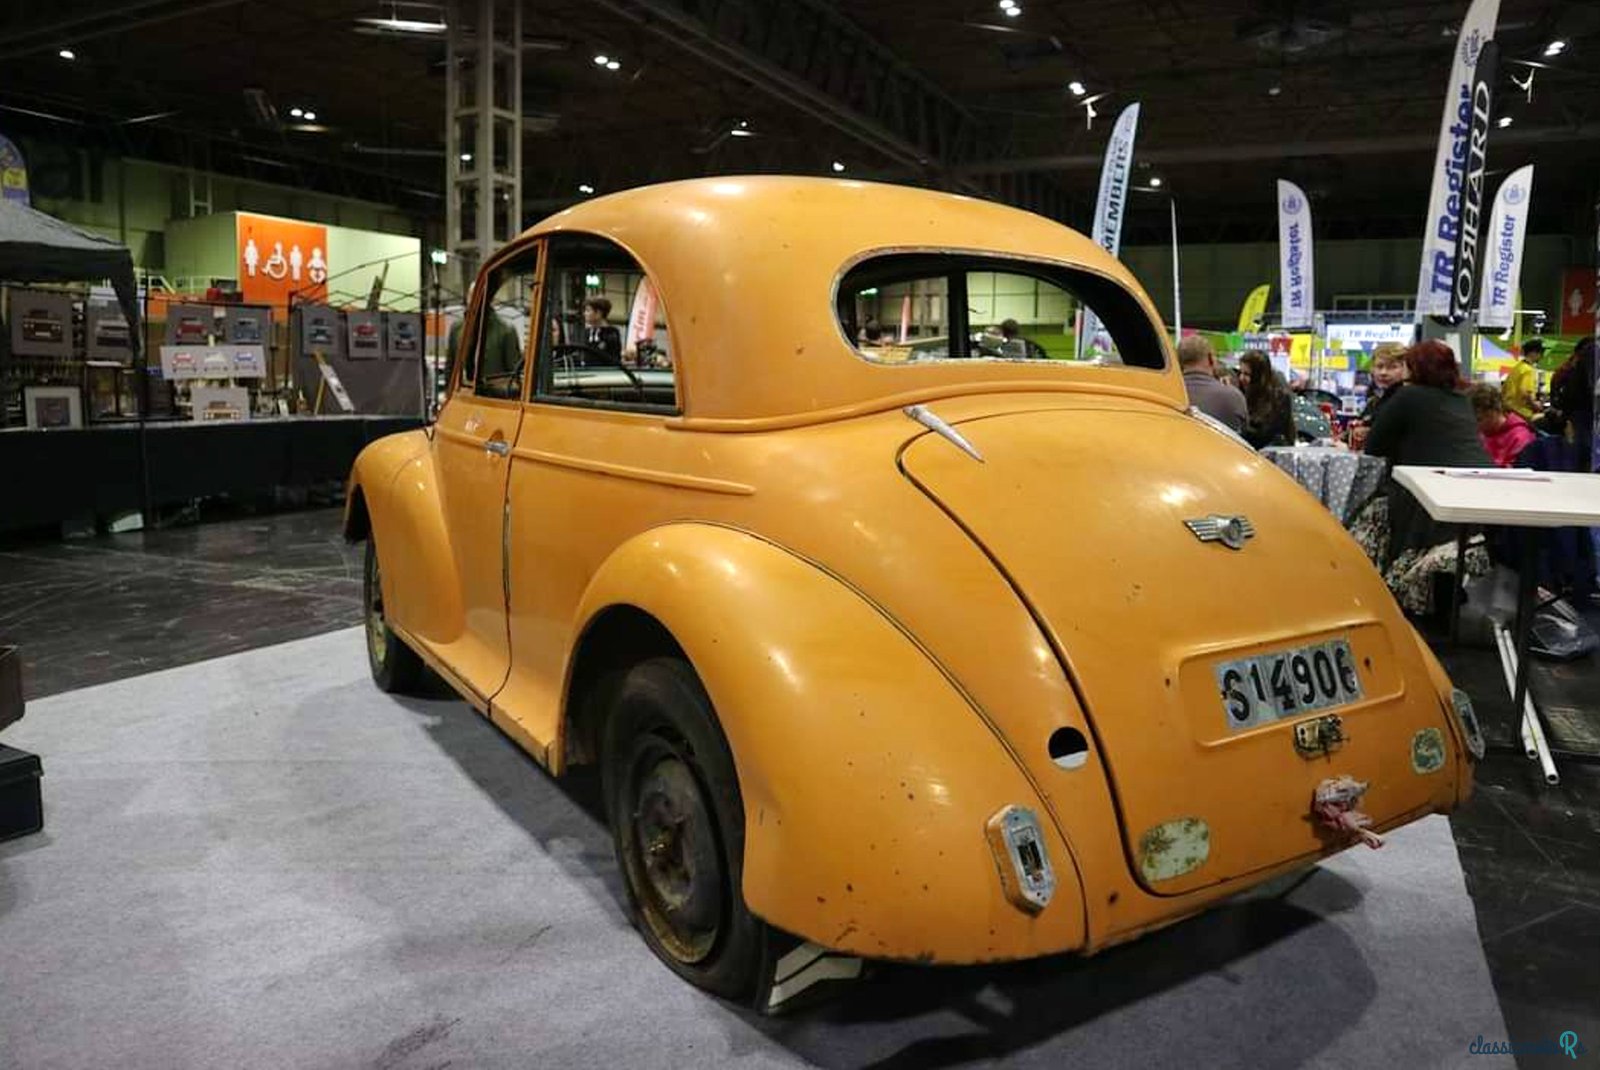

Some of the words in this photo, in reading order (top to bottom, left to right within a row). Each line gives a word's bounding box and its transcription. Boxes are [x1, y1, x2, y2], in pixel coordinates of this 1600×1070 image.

[1104, 140, 1129, 254] MEMBERS
[1437, 84, 1472, 243] Register
[1430, 250, 1455, 296] TR
[1497, 213, 1517, 287] Register
[1491, 272, 1506, 307] TR
